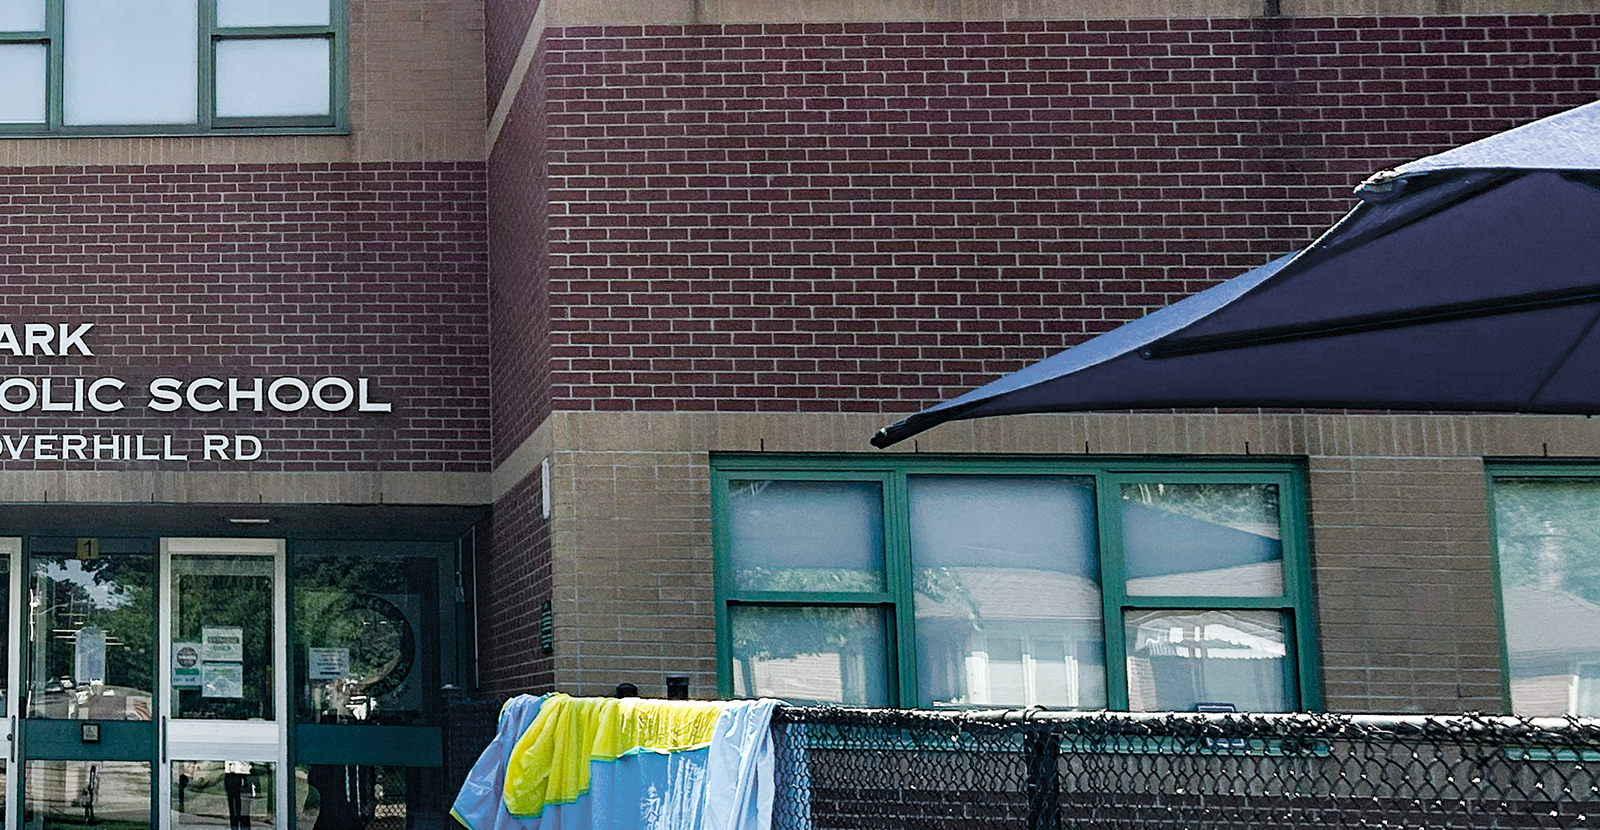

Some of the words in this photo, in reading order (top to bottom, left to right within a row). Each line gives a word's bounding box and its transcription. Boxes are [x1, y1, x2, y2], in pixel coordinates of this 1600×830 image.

[147, 377, 393, 413] SCHOOL
[203, 434, 263, 461] RD
[84, 540, 92, 556] 1
